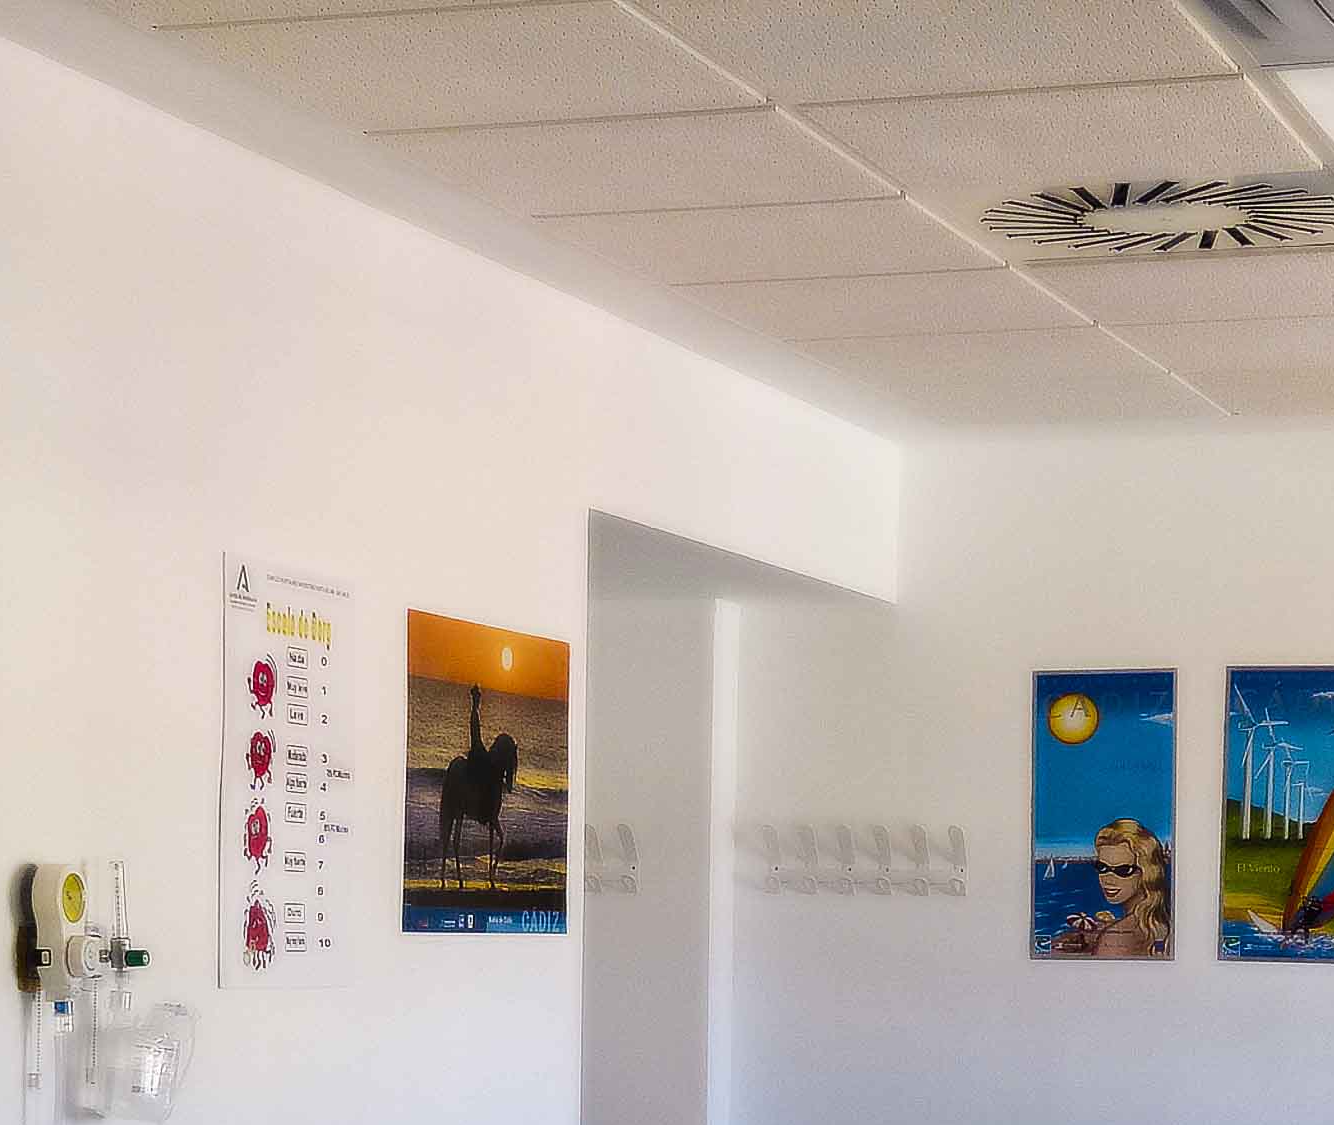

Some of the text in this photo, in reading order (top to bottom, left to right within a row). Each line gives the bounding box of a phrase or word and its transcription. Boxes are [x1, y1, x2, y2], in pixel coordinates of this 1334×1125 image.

[321, 656, 328, 666] 0
[321, 686, 327, 695] 1
[321, 714, 328, 724] 2
[321, 754, 328, 763] 3
[320, 782, 327, 792] 4
[319, 811, 326, 820] 5
[318, 835, 325, 844] 6
[318, 861, 324, 870] 7
[319, 939, 331, 948] 10
